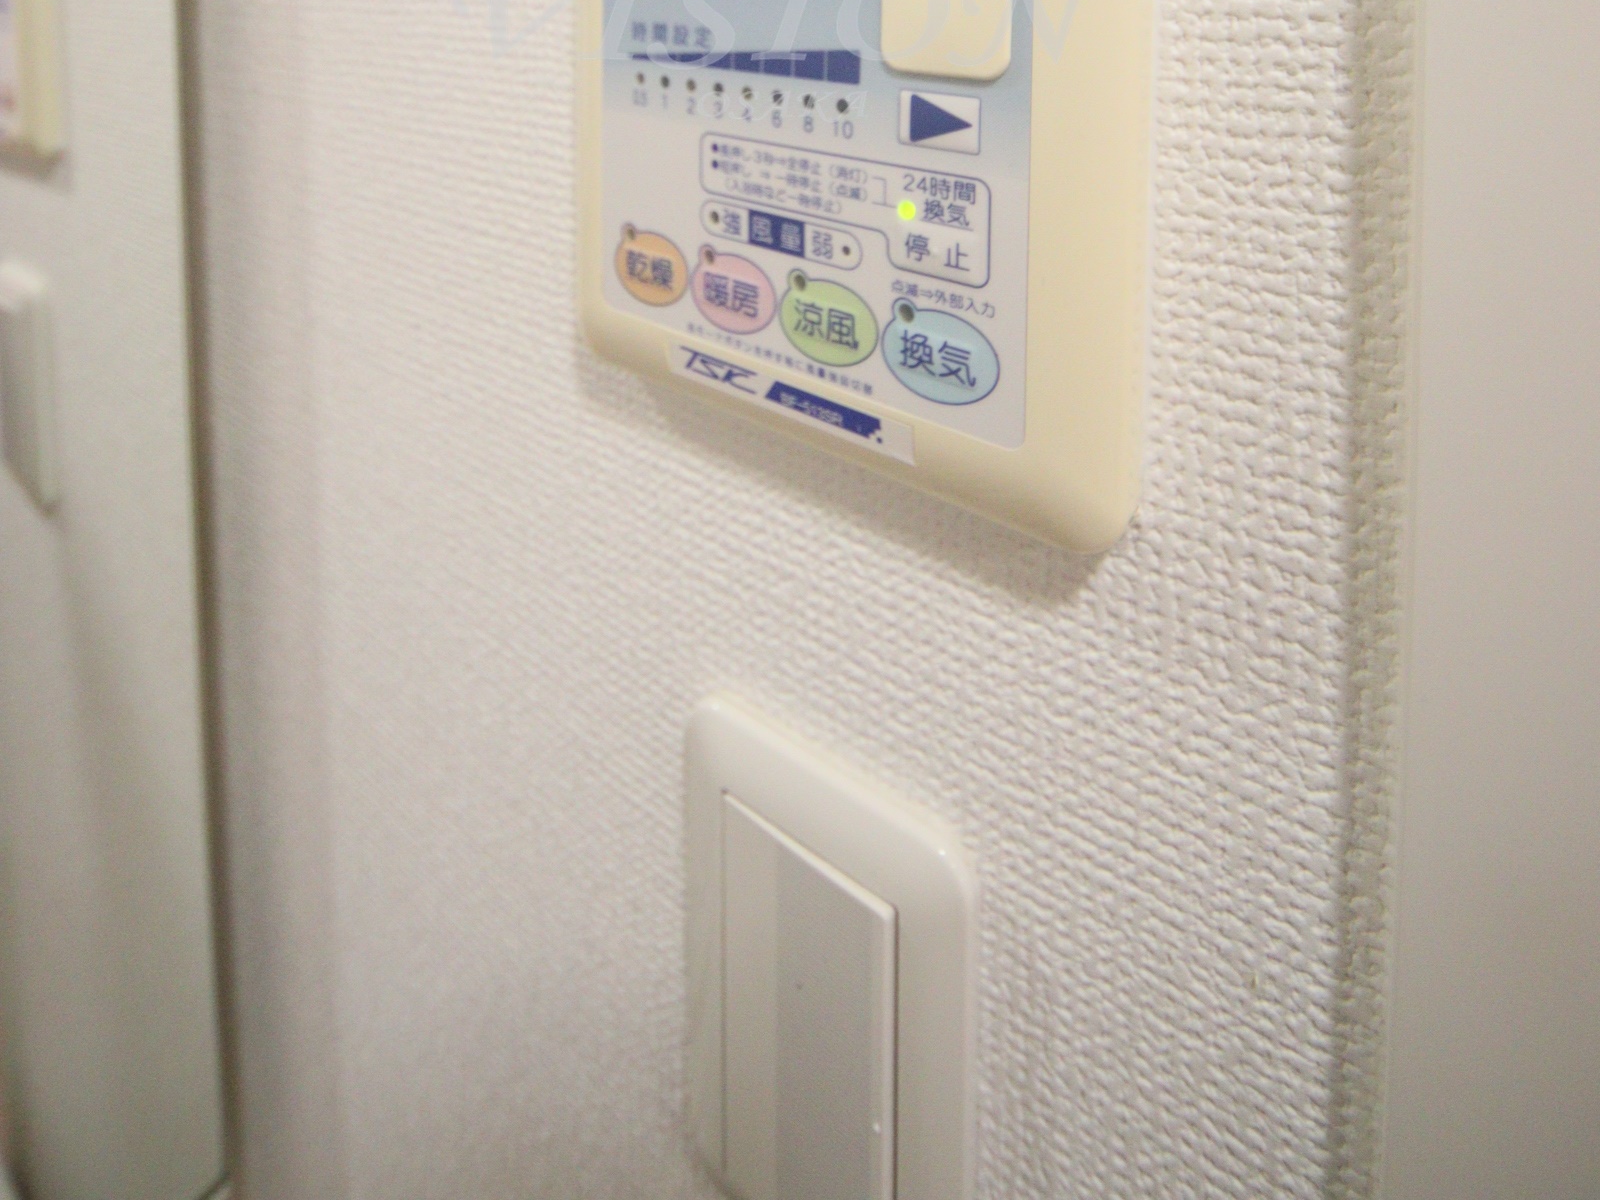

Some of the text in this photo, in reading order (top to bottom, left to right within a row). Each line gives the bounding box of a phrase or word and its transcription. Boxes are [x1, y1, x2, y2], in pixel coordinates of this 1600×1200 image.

[686, 96, 697, 115] 2
[803, 115, 815, 134] 8
[833, 119, 855, 140] 10
[903, 173, 977, 205] 24時間
[922, 198, 971, 227] 換気
[626, 249, 674, 292] 乾燥
[904, 232, 971, 272] 停止
[703, 271, 759, 319] 暖房
[794, 299, 859, 351] 涼風
[899, 329, 977, 388] 換気
